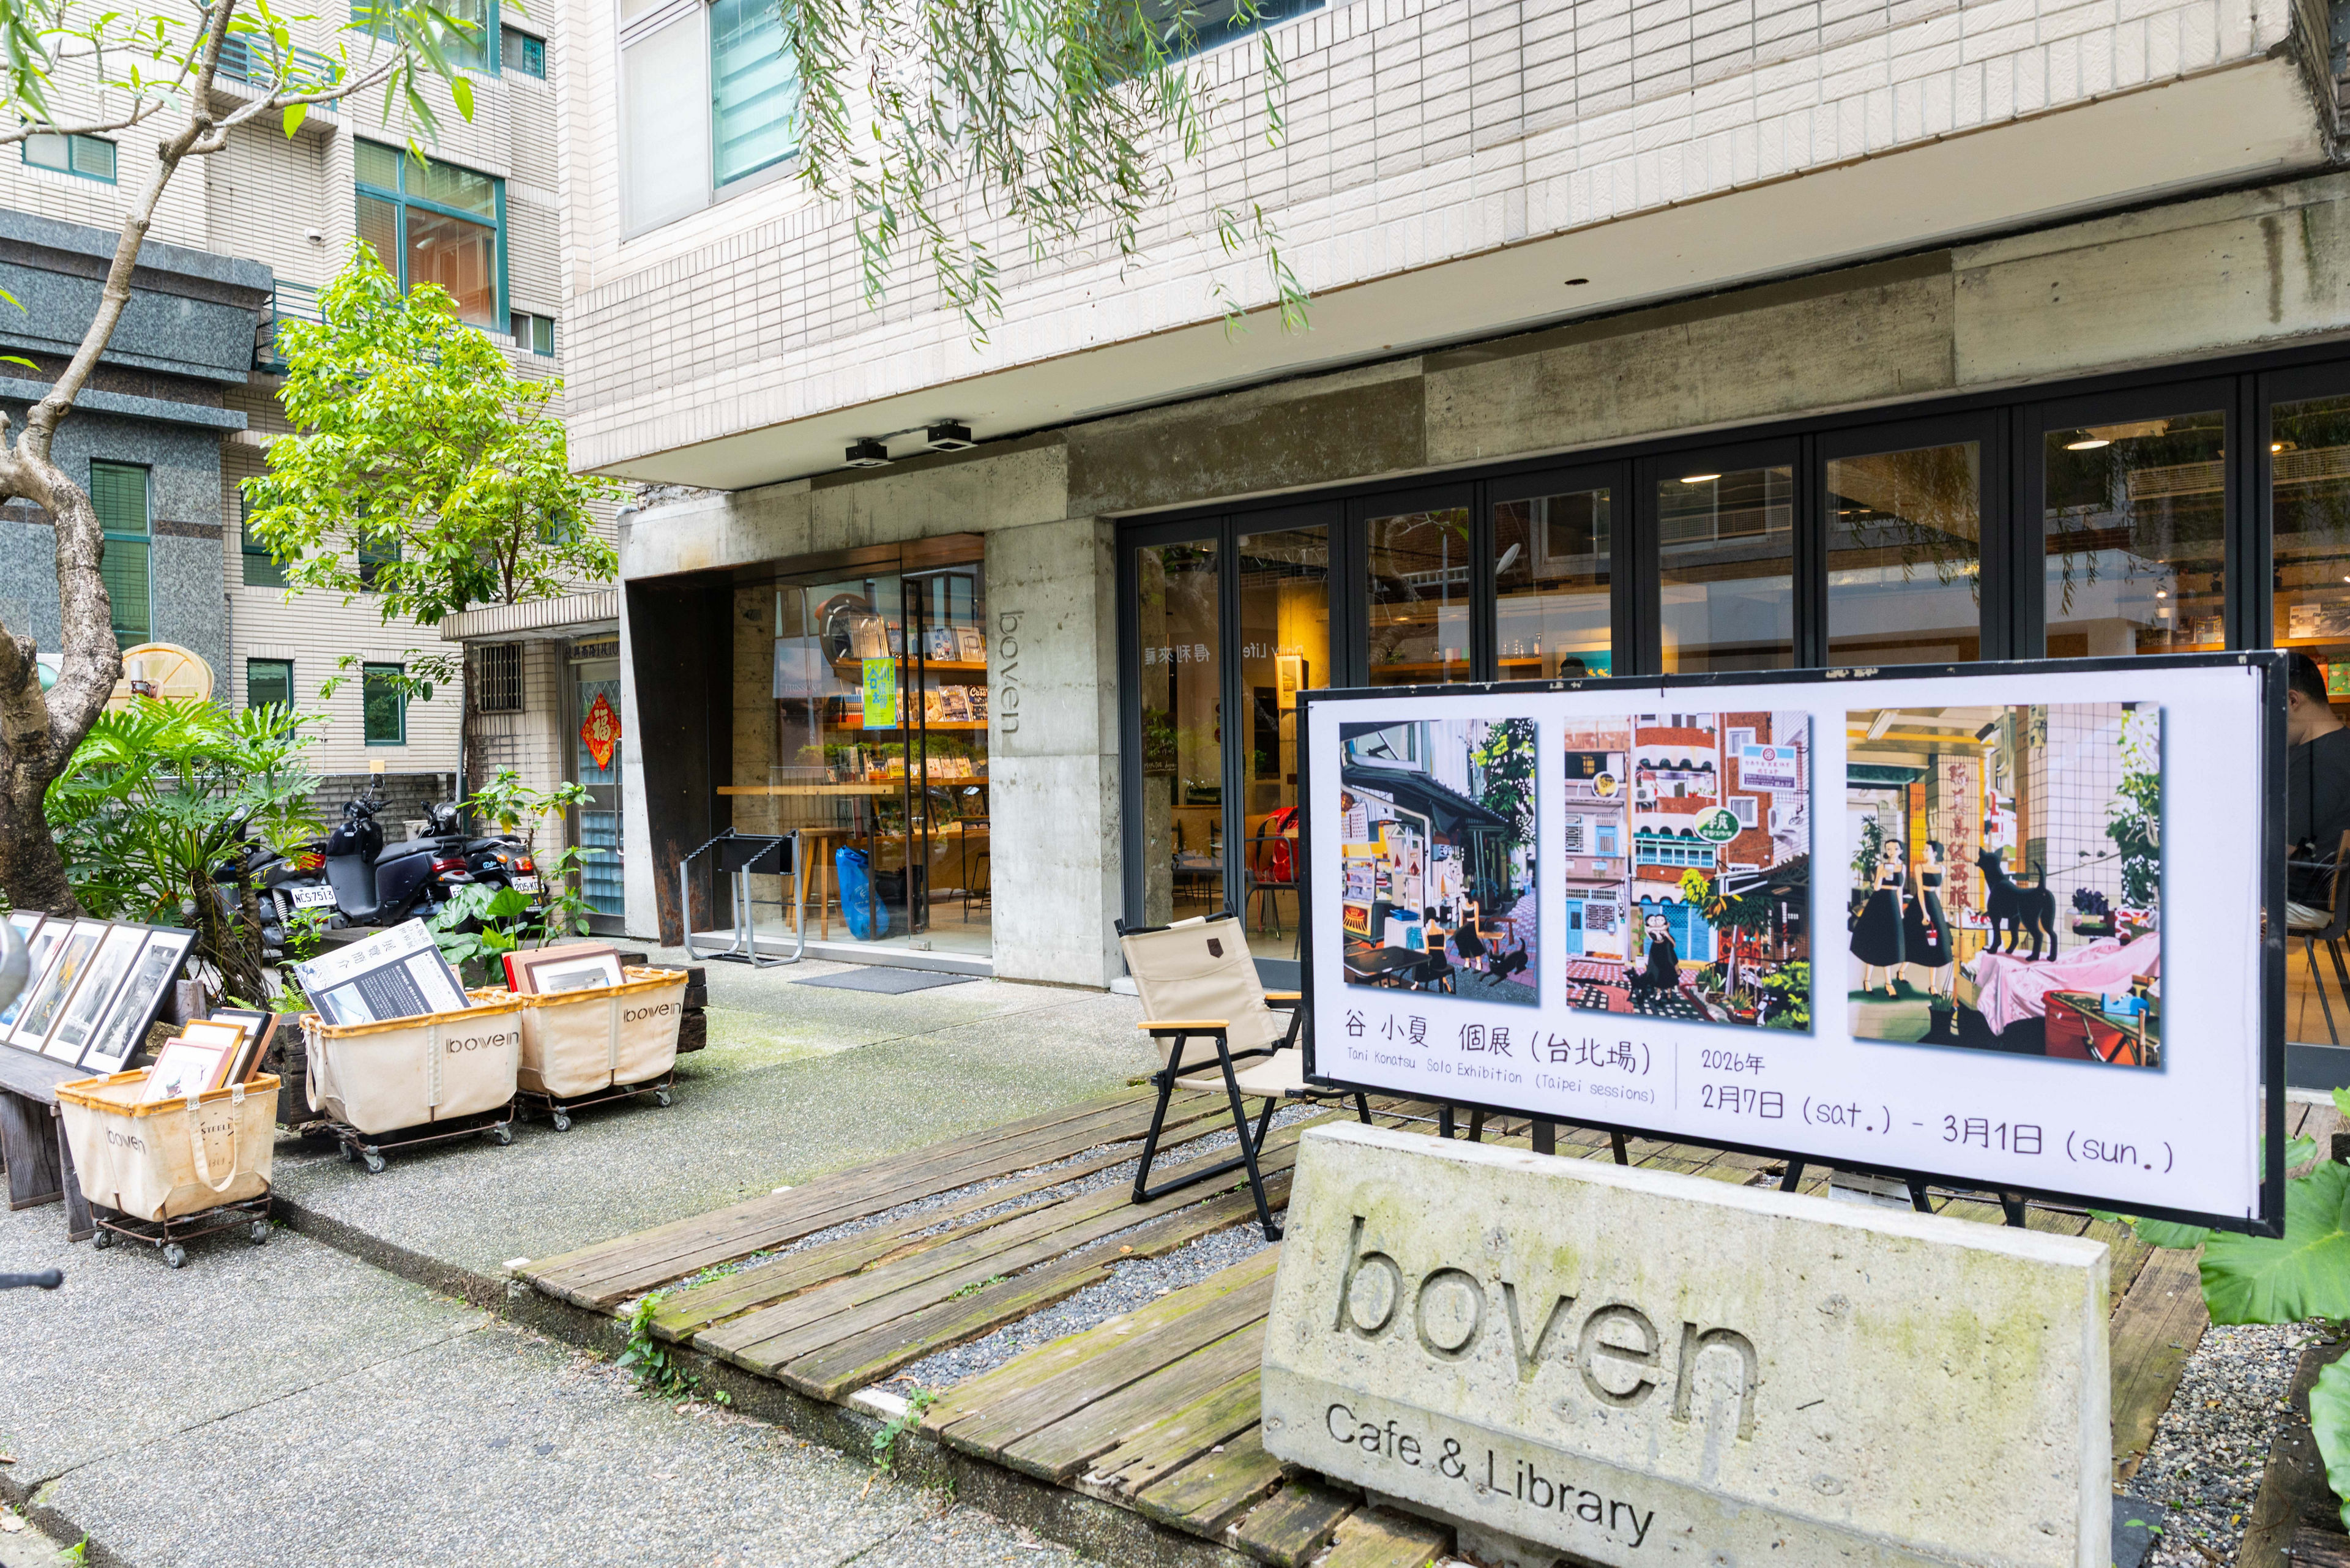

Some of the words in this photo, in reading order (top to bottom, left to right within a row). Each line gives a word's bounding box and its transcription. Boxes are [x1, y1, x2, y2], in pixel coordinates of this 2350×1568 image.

[999, 611, 1024, 734] boven
[592, 708, 611, 742] 福
[294, 890, 334, 903] NCS-7513
[624, 1002, 682, 1023] boven
[446, 1031, 520, 1054] boven
[1348, 1047, 1368, 1061] Tani
[1375, 1051, 1416, 1069] Konatsu
[1427, 1059, 1452, 1074] Solo
[1458, 1062, 1523, 1084] Exhibition
[1535, 1074, 1581, 1093] (Taipei
[1590, 1083, 1655, 1103] sessions)
[1701, 1049, 1766, 1075] 2026年
[107, 1126, 146, 1155] boven
[1701, 1085, 1783, 1119] 2月7日
[1803, 1096, 1890, 1135] (sat.)
[1943, 1115, 2042, 1155] 3月1日
[2067, 1130, 2173, 1173] (sun.)
[1333, 1214, 1759, 1444] boven
[1325, 1403, 1422, 1468] Cafe
[1439, 1438, 1468, 1479] &
[1486, 1449, 1656, 1549] Library
